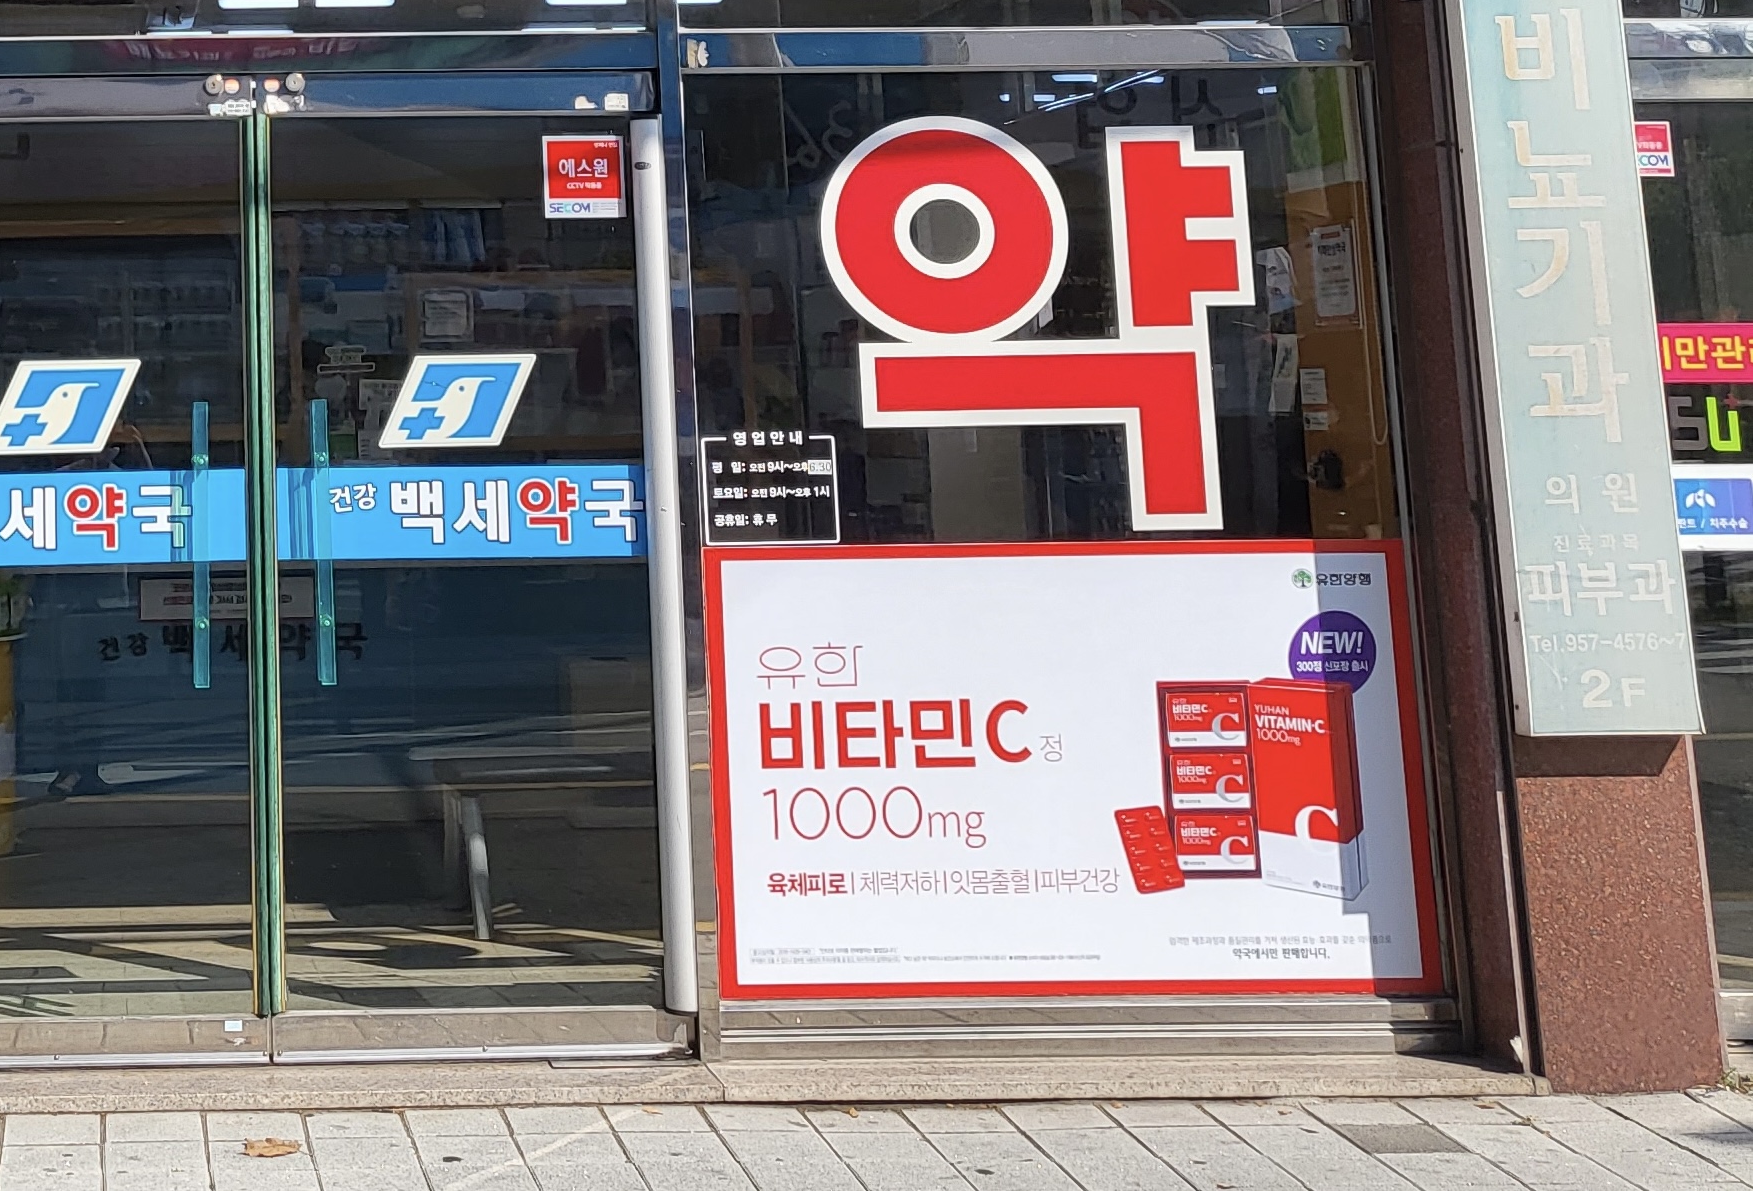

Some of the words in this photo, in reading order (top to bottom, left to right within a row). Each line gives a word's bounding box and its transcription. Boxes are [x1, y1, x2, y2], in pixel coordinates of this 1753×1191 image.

[558, 158, 608, 178] 에스원
[549, 202, 591, 213] SECOM
[819, 115, 1256, 532] 약
[328, 483, 377, 513] 건강
[390, 477, 644, 545] 백세약국
[1316, 572, 1372, 586] 유한양행
[1525, 559, 1676, 617] 피부과
[1300, 631, 1364, 654] NEW!
[757, 641, 863, 690] 유한
[1580, 668, 1645, 708] 2F
[1254, 703, 1289, 715] YUHAN
[1256, 727, 1301, 746] 1000mg
[762, 785, 987, 848] 1000mg
